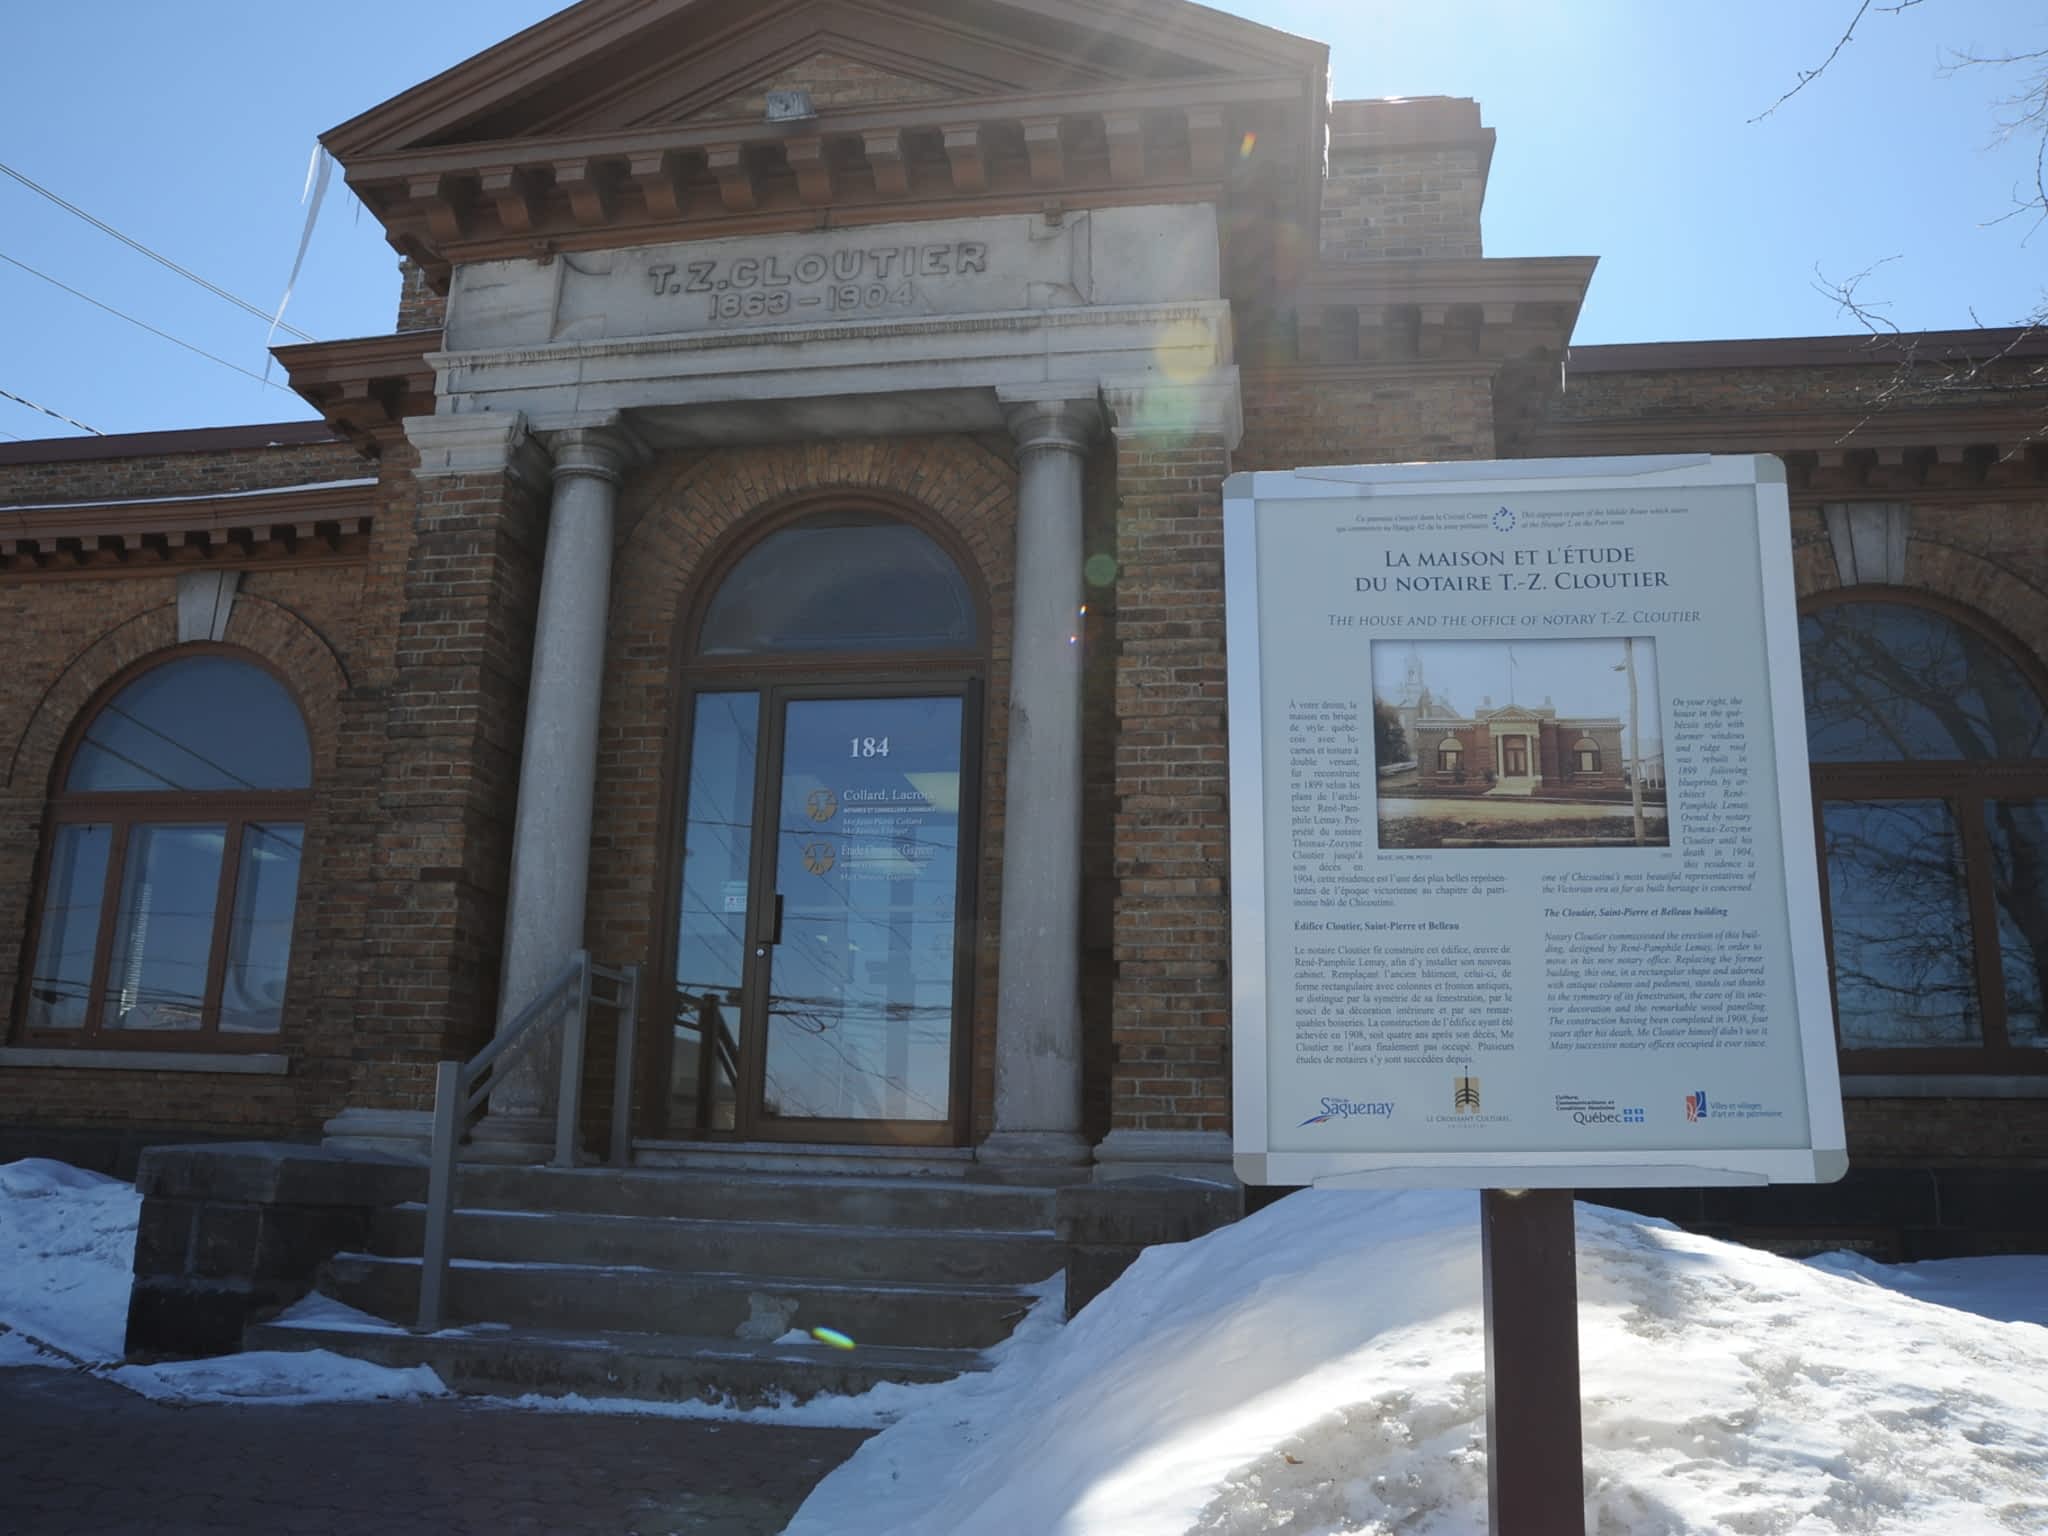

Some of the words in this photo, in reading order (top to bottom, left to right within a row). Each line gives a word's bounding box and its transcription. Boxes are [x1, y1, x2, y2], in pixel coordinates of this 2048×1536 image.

[1384, 550, 1410, 567] LA
[1416, 551, 1505, 566] MAISON
[1514, 550, 1539, 565] ET
[1547, 545, 1636, 564] L'ÉTUDE
[1355, 577, 1387, 592] DU
[1396, 576, 1490, 592] NOTAIRE
[1498, 573, 1547, 591] T.-Z.
[1555, 572, 1669, 590] CLOUTIER
[1328, 614, 1353, 626] THE
[1359, 615, 1402, 626] HOUSE
[1407, 615, 1437, 626] AND
[1441, 615, 1467, 626] THE
[1471, 614, 1517, 626] OFFICE
[1520, 614, 1538, 626] OF
[1542, 613, 1597, 625] NOTARY
[1633, 610, 1701, 623] CLOUTIER
[850, 736, 889, 758] 184
[843, 789, 888, 801] Collard,
[1320, 1097, 1394, 1119] Saguenay
[1573, 1111, 1622, 1126] Québec
